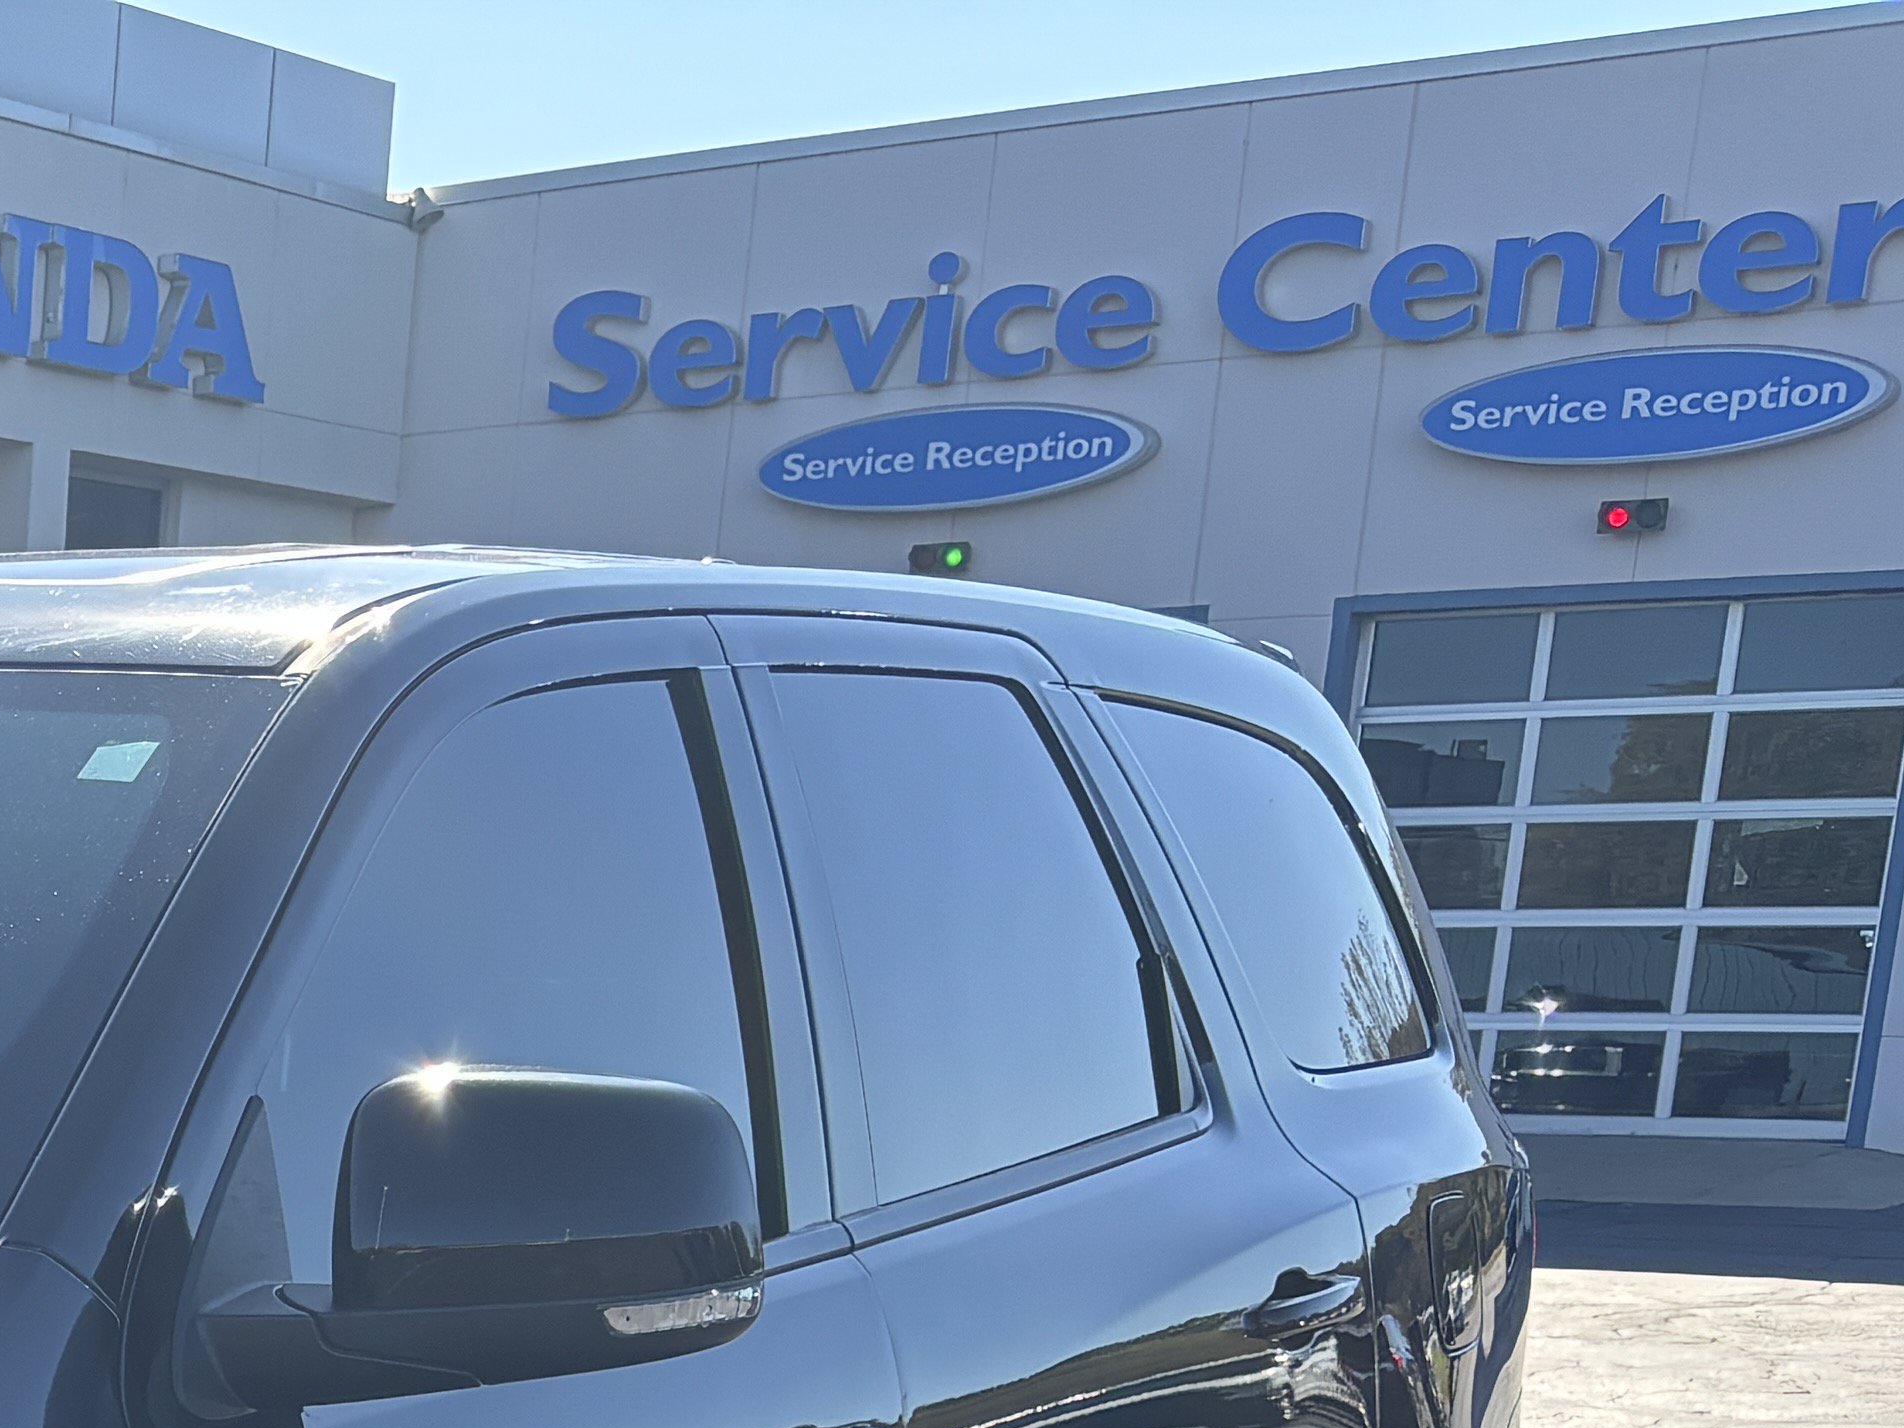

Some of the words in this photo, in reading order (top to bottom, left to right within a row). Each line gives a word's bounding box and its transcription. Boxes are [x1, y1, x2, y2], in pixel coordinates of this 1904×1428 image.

[548, 251, 1160, 418] Service
[1217, 193, 1904, 352] Center
[1450, 394, 1607, 431] Service
[1620, 376, 1848, 421] Reception
[782, 448, 914, 482] Service
[925, 431, 1113, 473] Reception
